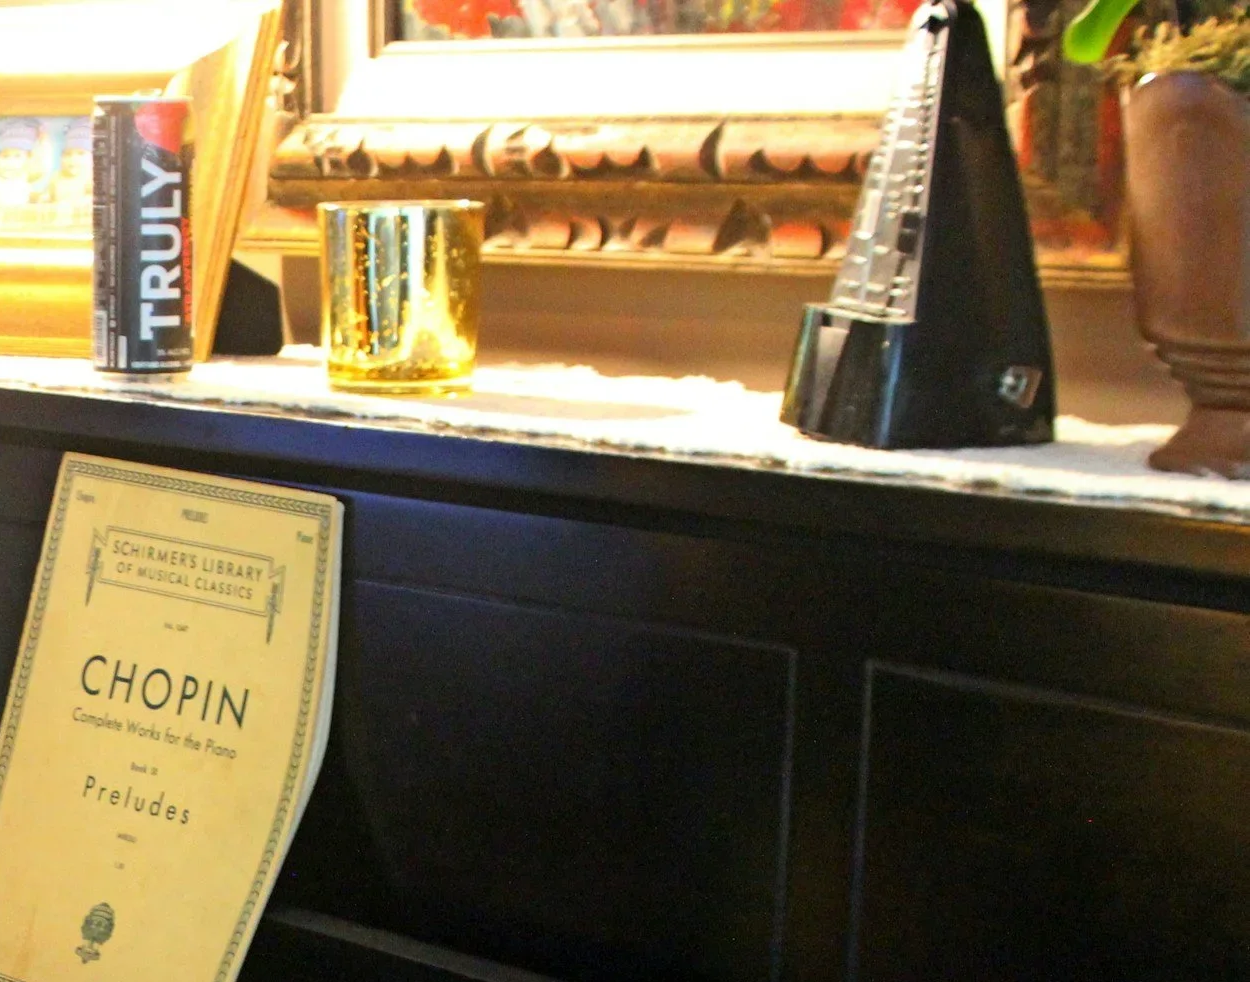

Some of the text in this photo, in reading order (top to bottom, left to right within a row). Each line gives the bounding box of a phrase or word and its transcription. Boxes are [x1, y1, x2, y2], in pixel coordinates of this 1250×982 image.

[139, 157, 182, 341] TRULY
[112, 539, 264, 583] SCHIRMER'S LIBRARY
[116, 561, 254, 600] OF MUSICAL CLASSICS
[81, 655, 250, 730] CHOPIN
[72, 706, 238, 760] Complete Works for the Piano
[81, 774, 191, 825] Preludes
